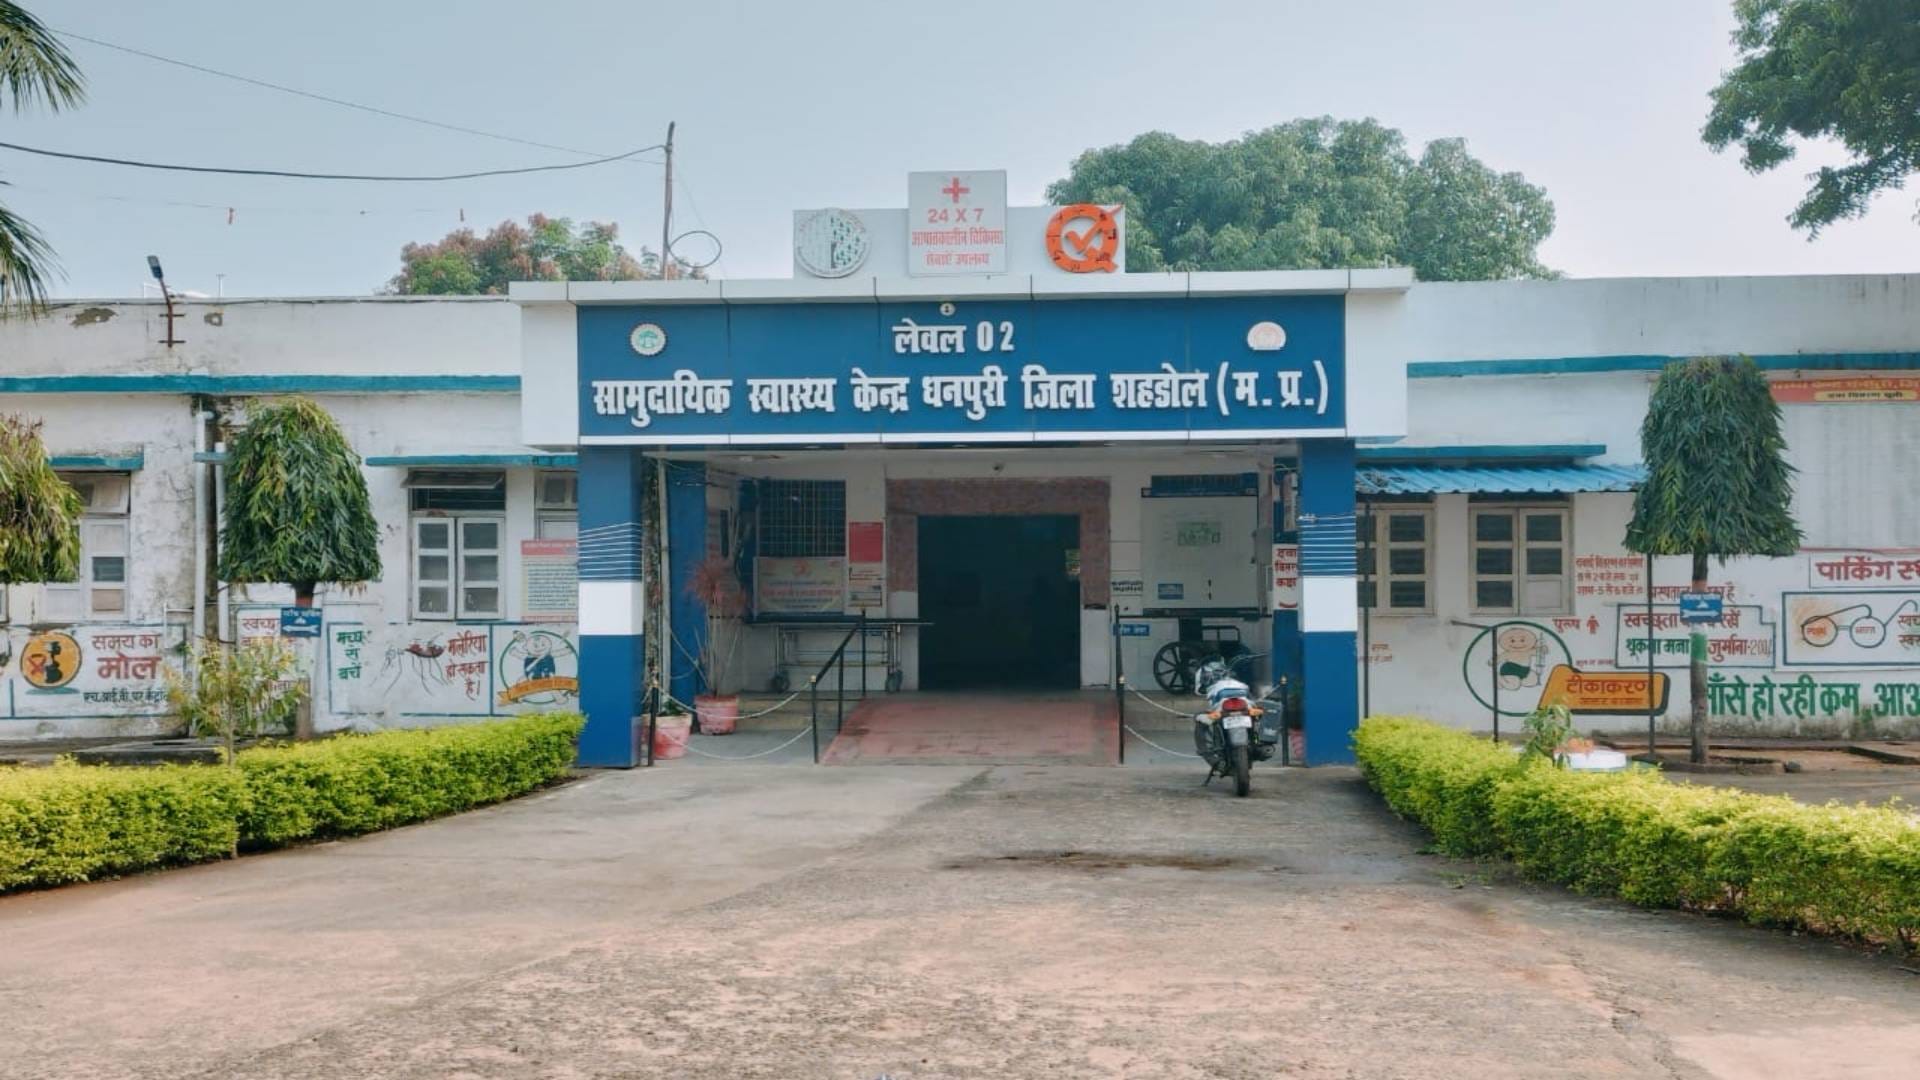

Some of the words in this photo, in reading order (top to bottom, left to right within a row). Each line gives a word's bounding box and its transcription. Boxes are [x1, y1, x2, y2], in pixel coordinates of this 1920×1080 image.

[927, 208, 950, 223] 24
[973, 208, 985, 222] 7
[892, 318, 967, 353] लेवल
[592, 369, 733, 428] सामुदायिक
[747, 378, 837, 413] स्वास्थ्य
[850, 367, 910, 413] केन्द्र
[922, 365, 1008, 421] धनपुरी
[1021, 364, 1097, 410] जिला
[1110, 363, 1209, 409] शहडोल
[1815, 556, 1894, 580] पार्किंग
[92, 634, 135, 649] समय
[139, 633, 162, 649] का
[97, 652, 163, 679] मोल
[1565, 674, 1648, 694] टीकाकरण
[1752, 675, 1776, 722] हो
[1779, 674, 1818, 719] रही
[1820, 683, 1861, 716] कम
